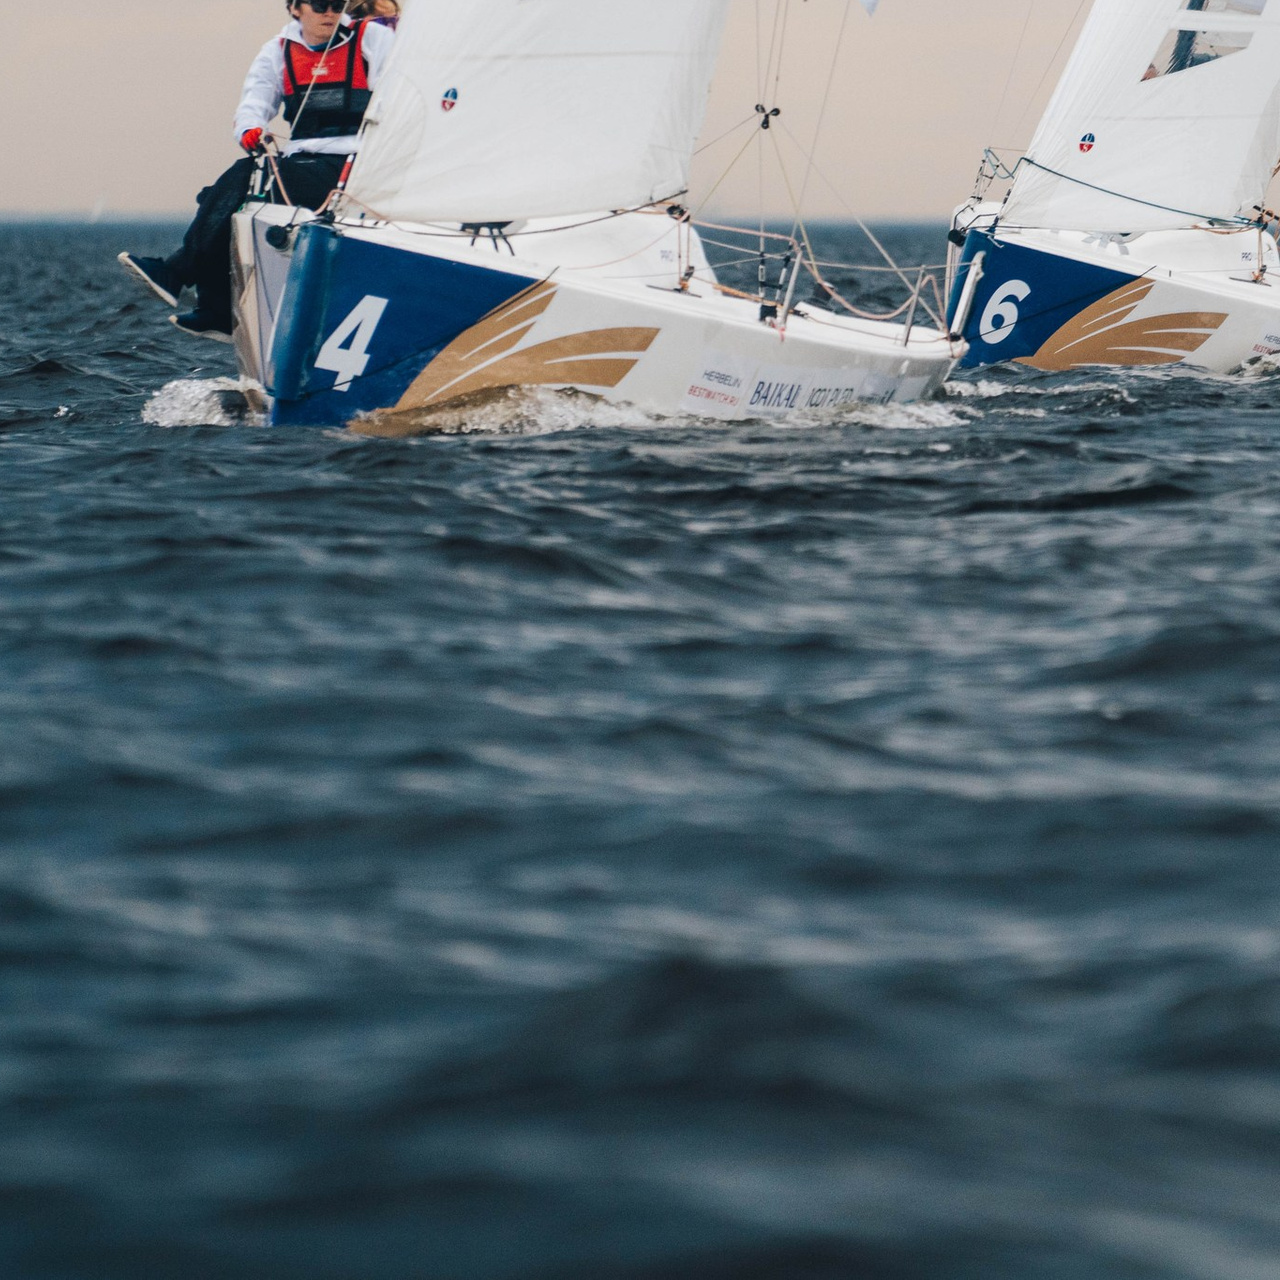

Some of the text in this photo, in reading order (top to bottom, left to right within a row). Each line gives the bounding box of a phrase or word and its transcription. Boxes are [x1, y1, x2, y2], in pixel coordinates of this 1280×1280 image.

[313, 294, 389, 392] 4
[978, 279, 1031, 345] 6
[749, 381, 801, 408] BAIKAL
